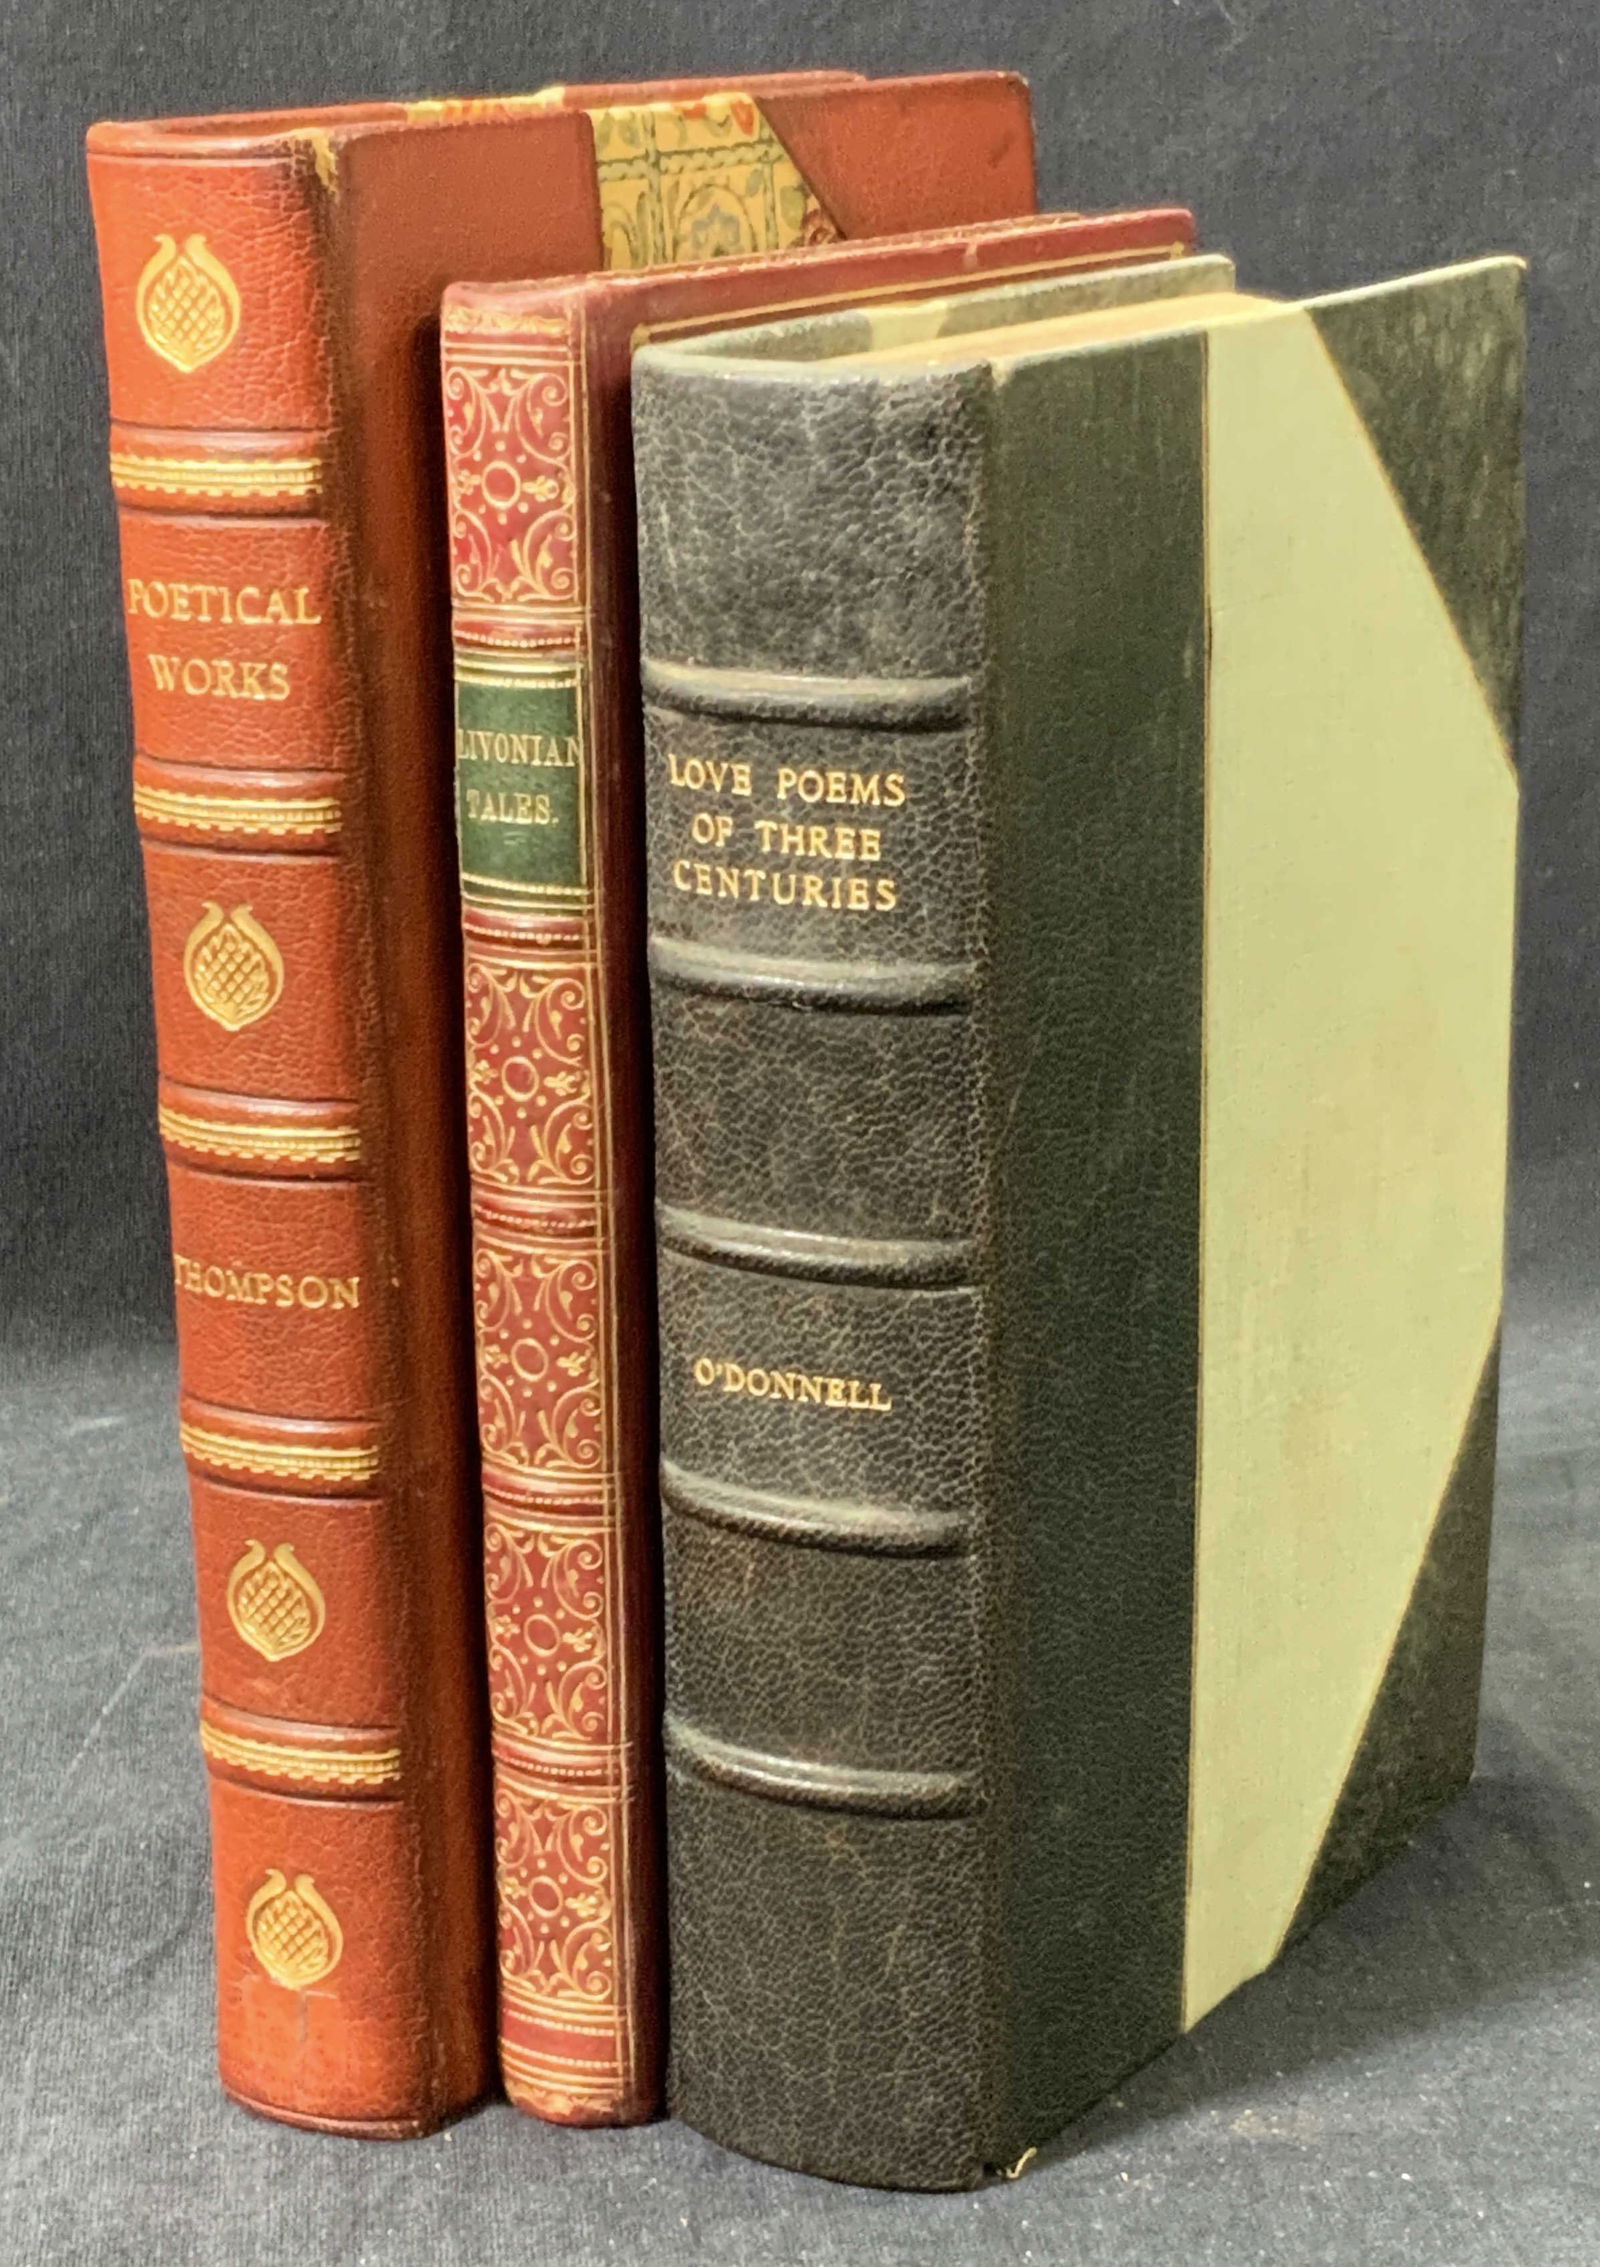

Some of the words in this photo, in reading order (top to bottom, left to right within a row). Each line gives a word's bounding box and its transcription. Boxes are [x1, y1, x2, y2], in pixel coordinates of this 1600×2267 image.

[127, 578, 322, 625] POETICAL
[147, 653, 291, 701] WORKS
[667, 753, 752, 797] LOVE
[777, 767, 906, 807] POEMS
[466, 788, 560, 825] TALES.
[691, 812, 734, 848] OF
[754, 819, 881, 862] THREE
[673, 860, 897, 912] CENTURIES
[173, 1252, 361, 1310] THOMPSON
[694, 1357, 893, 1412] O'DONNELL
